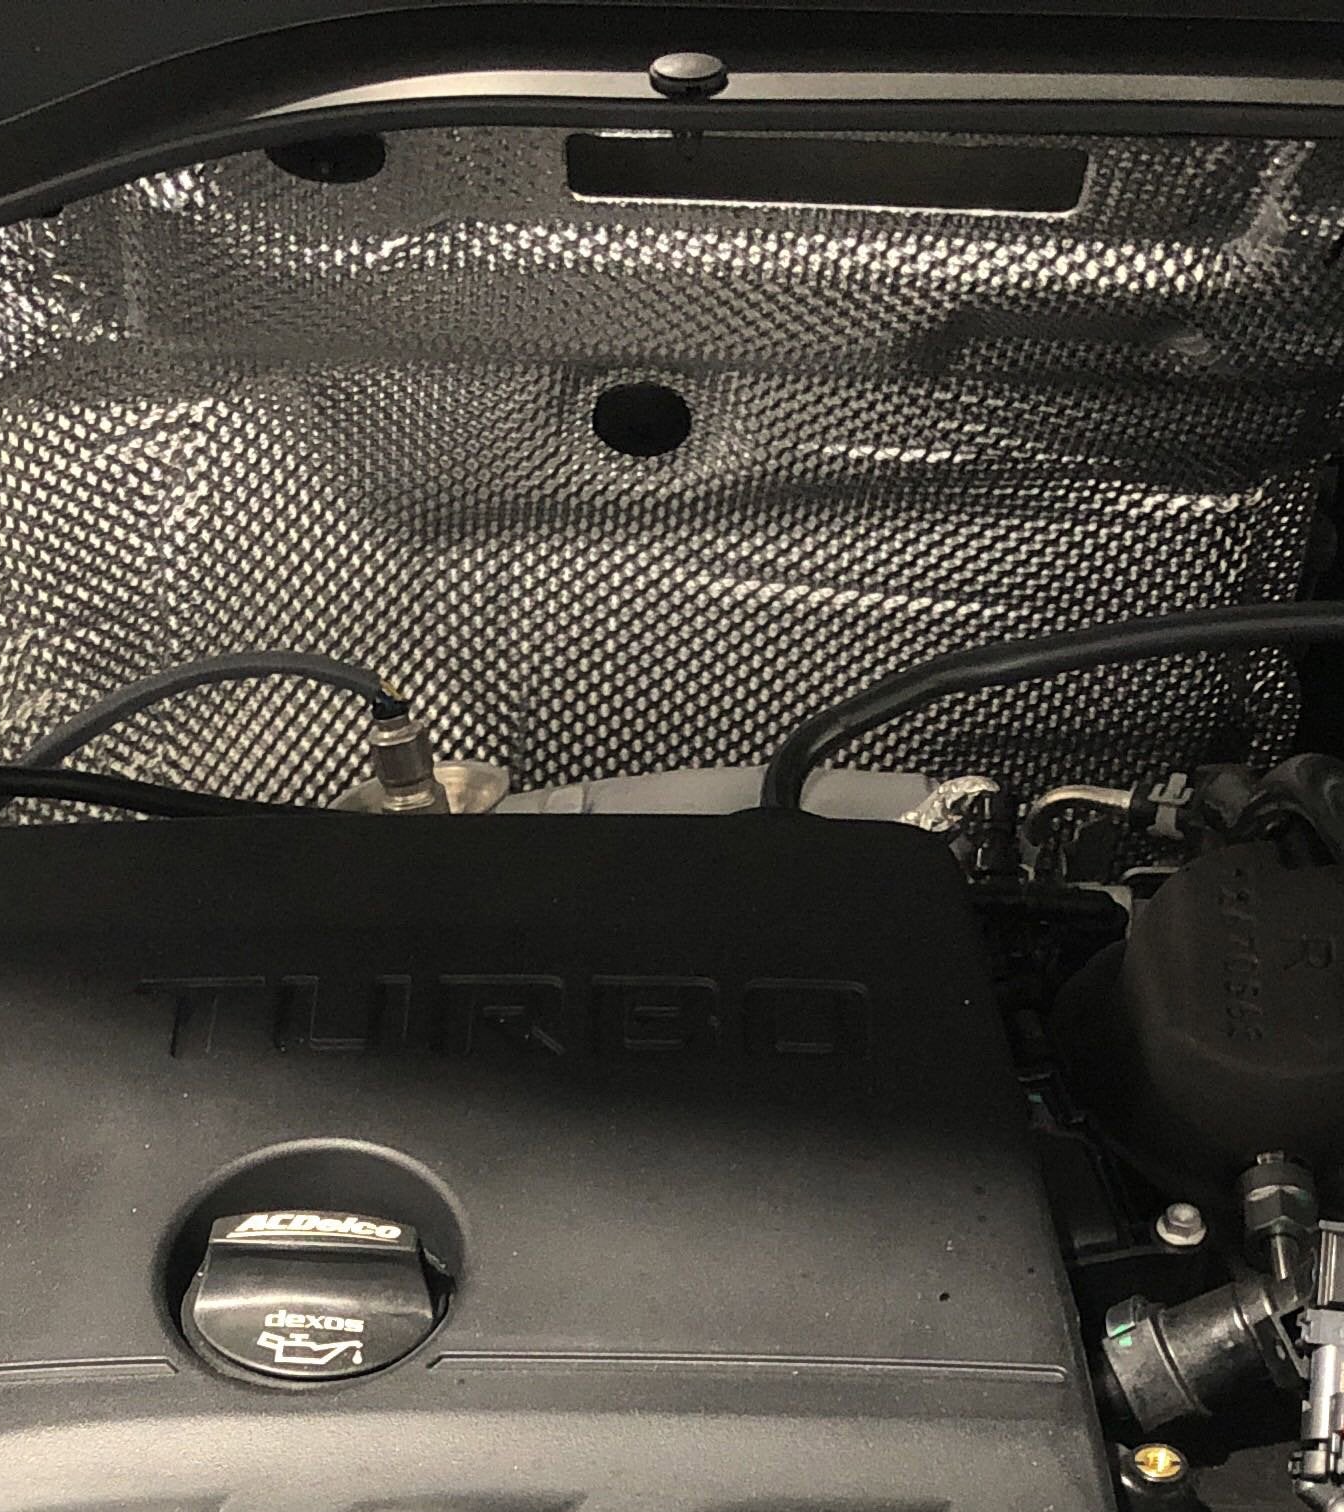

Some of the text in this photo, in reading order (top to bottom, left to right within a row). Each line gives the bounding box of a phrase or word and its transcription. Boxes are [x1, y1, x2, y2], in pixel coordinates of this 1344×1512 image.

[139, 973, 870, 1060] TURBO
[227, 1213, 402, 1242] ACDelco
[264, 1309, 365, 1333] dexos
